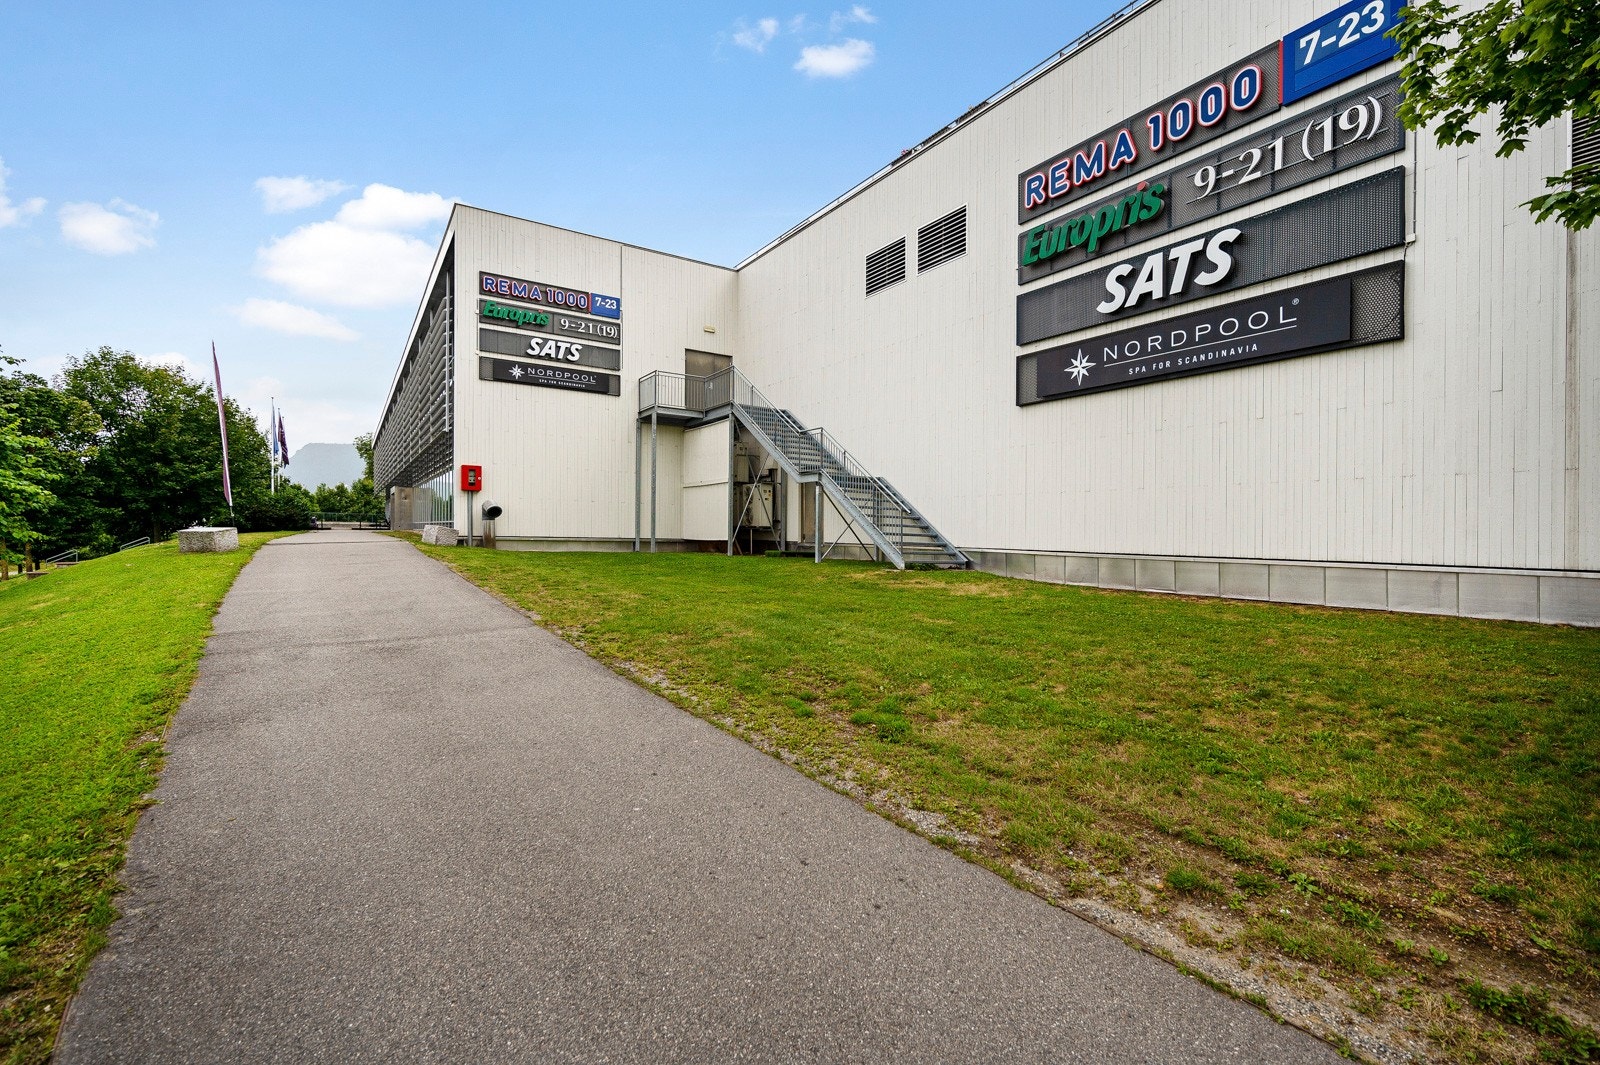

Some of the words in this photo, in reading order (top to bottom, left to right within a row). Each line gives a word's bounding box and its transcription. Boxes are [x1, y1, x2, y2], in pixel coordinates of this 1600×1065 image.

[1299, 0, 1385, 65] 7-23
[1024, 128, 1137, 209] REMA
[1147, 64, 1263, 152] 1000
[1194, 137, 1283, 200] 9-21
[1302, 96, 1382, 161] (19)
[1022, 181, 1165, 267] Europris
[1096, 228, 1242, 314] SATS
[483, 276, 542, 301] REMA
[546, 287, 588, 309] 1000
[595, 297, 617, 309] 7-23
[483, 300, 550, 326] Europris
[560, 319, 593, 334] 9-21
[597, 323, 618, 338] (19)
[526, 338, 582, 362] SATS
[1128, 364, 1146, 375] SPA
[1152, 360, 1171, 370] FOR
[1178, 343, 1259, 365] SCANDINAVIA
